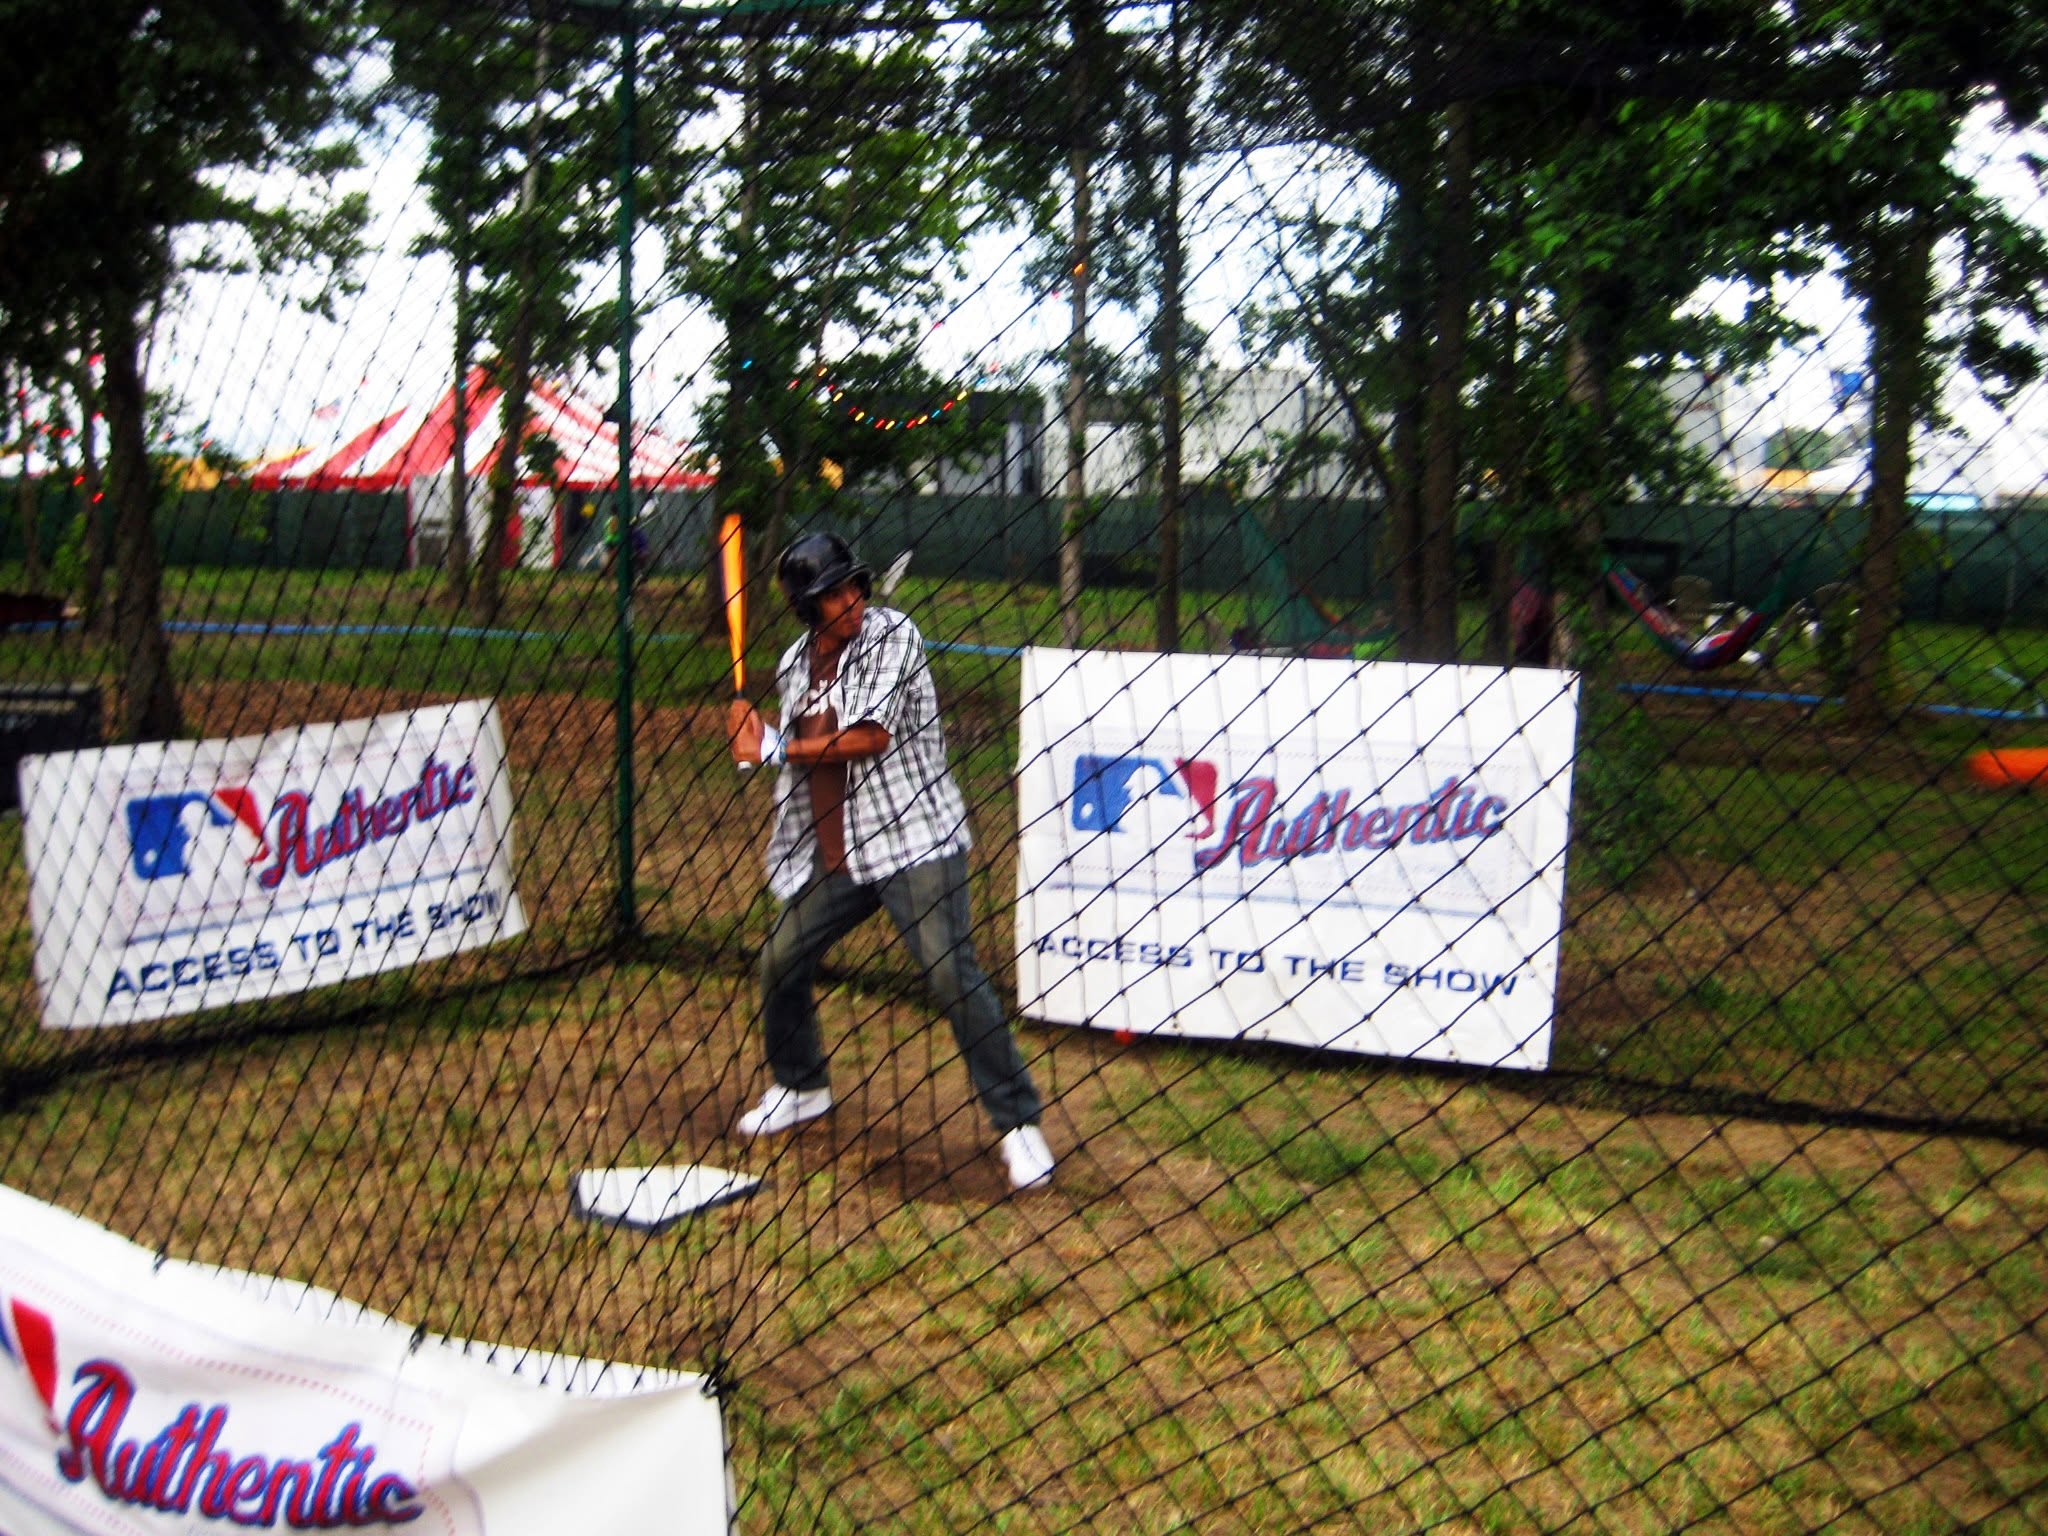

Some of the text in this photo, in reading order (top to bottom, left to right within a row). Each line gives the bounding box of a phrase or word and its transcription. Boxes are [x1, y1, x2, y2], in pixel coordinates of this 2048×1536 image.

[258, 758, 476, 890] Authentic
[1194, 775, 1508, 870] Authentic
[107, 942, 279, 999] ACCESS
[290, 927, 341, 962] TO
[353, 908, 416, 944] THE
[1037, 935, 1193, 967] ACCESS
[1211, 947, 1265, 973] TO
[1284, 955, 1365, 982] THE
[58, 1360, 425, 1527] Authentic
